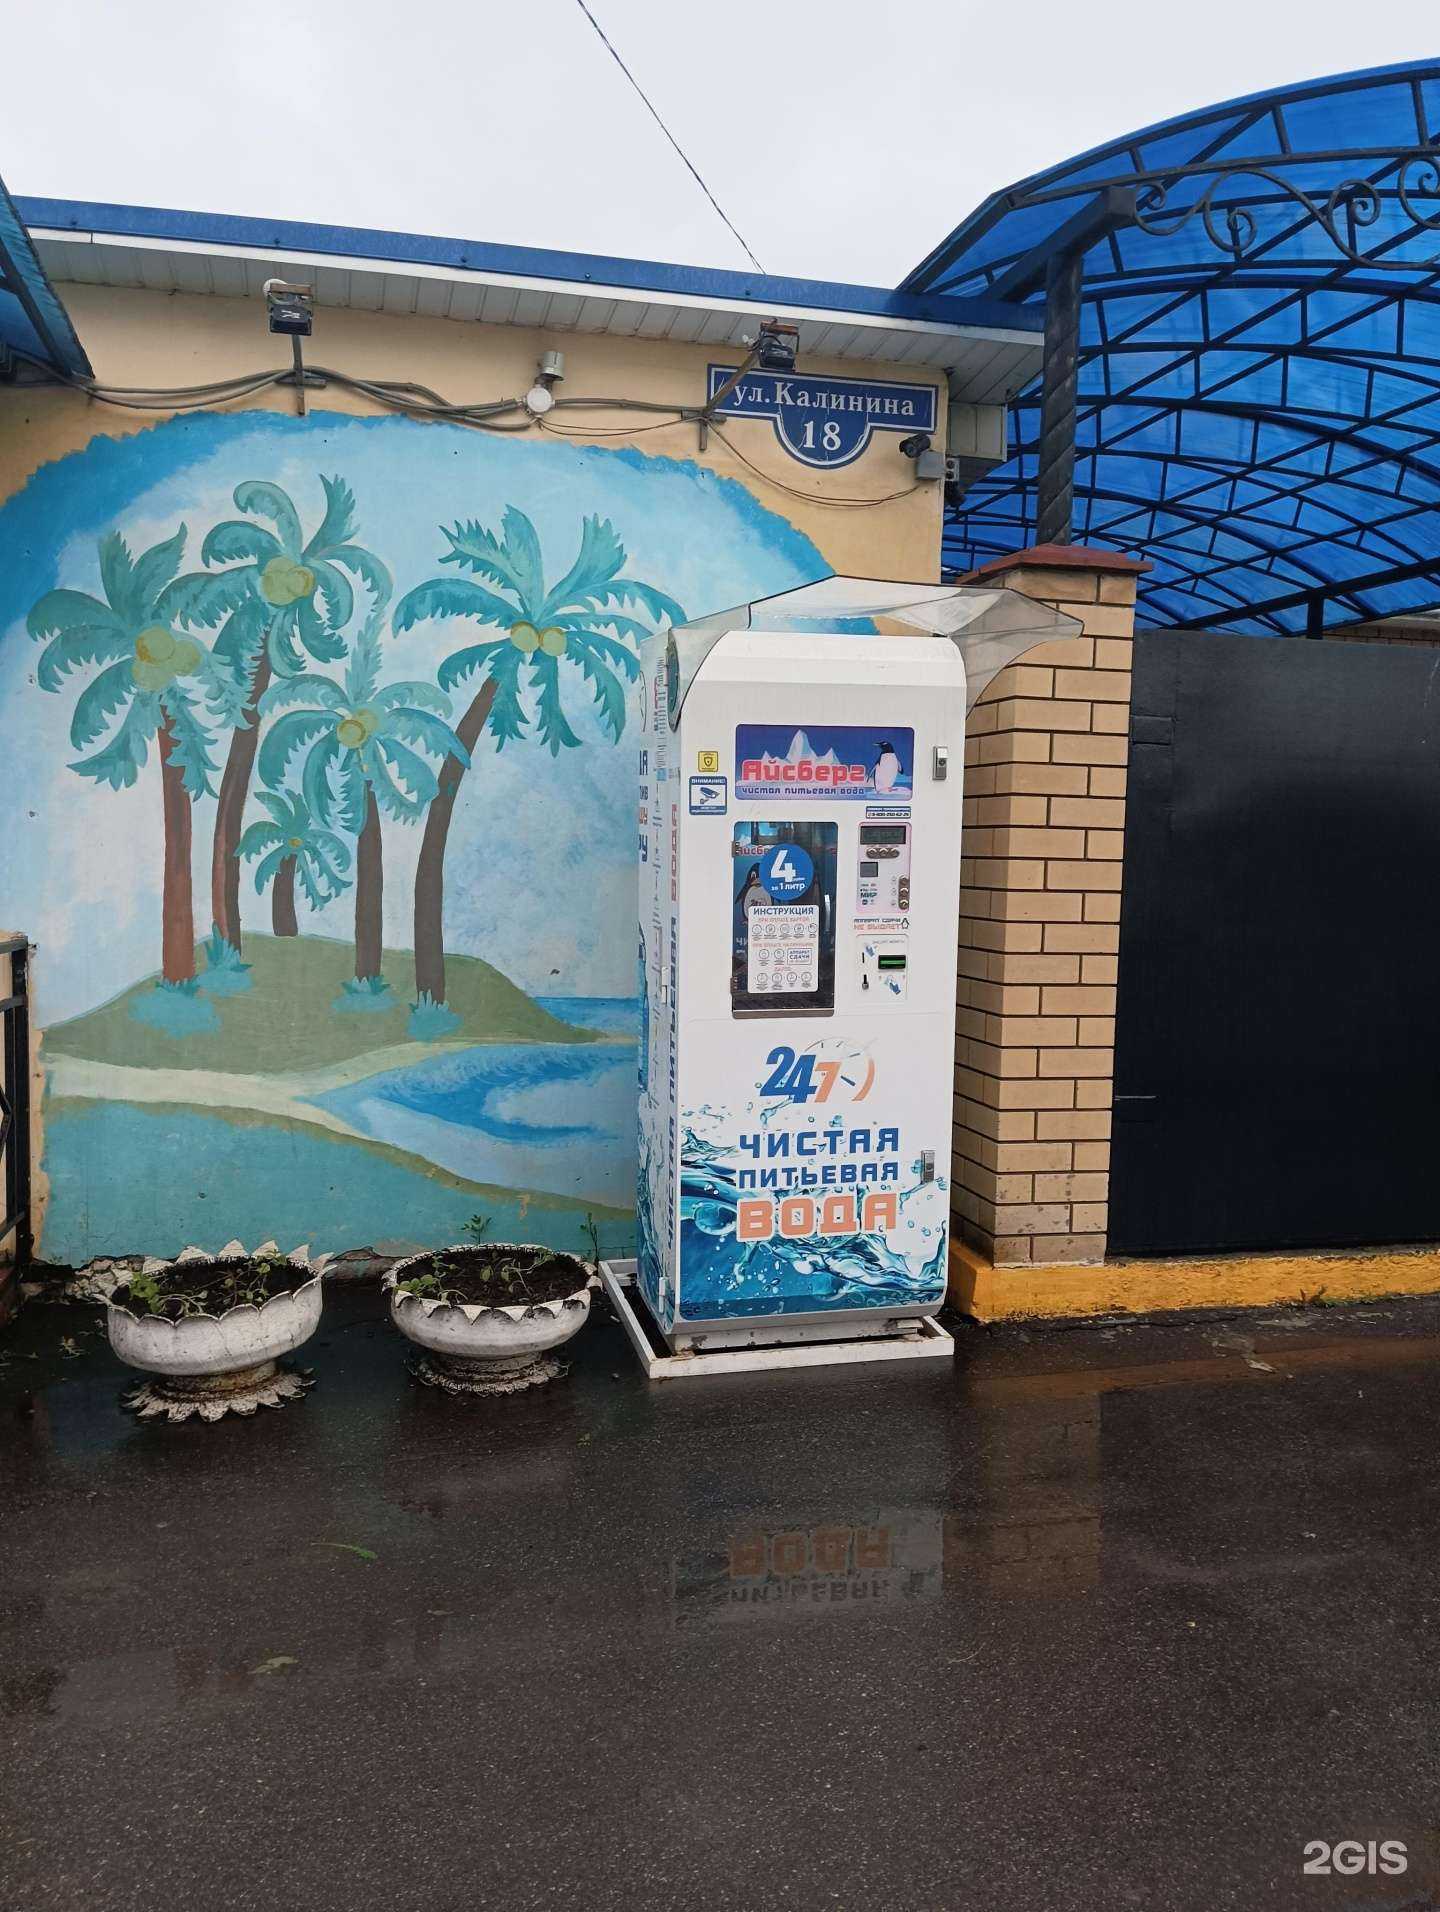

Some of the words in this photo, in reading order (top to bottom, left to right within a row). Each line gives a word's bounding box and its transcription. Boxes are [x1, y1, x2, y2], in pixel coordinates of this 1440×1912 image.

[733, 384, 770, 406] ул.
[774, 381, 916, 416] Калинина
[803, 420, 841, 451] 18
[743, 760, 865, 786] Айсберг
[784, 787, 836, 795] питьевая
[840, 787, 865, 795] вода
[770, 849, 796, 883] 4
[784, 882, 806, 891] литр
[753, 906, 814, 916] ИНСТРУКЦИЯ
[738, 1127, 900, 1159] ЧИСТАЯ
[738, 1162, 899, 1189] ПИТЬЕВАЯ
[738, 1192, 898, 1240] ВОДА
